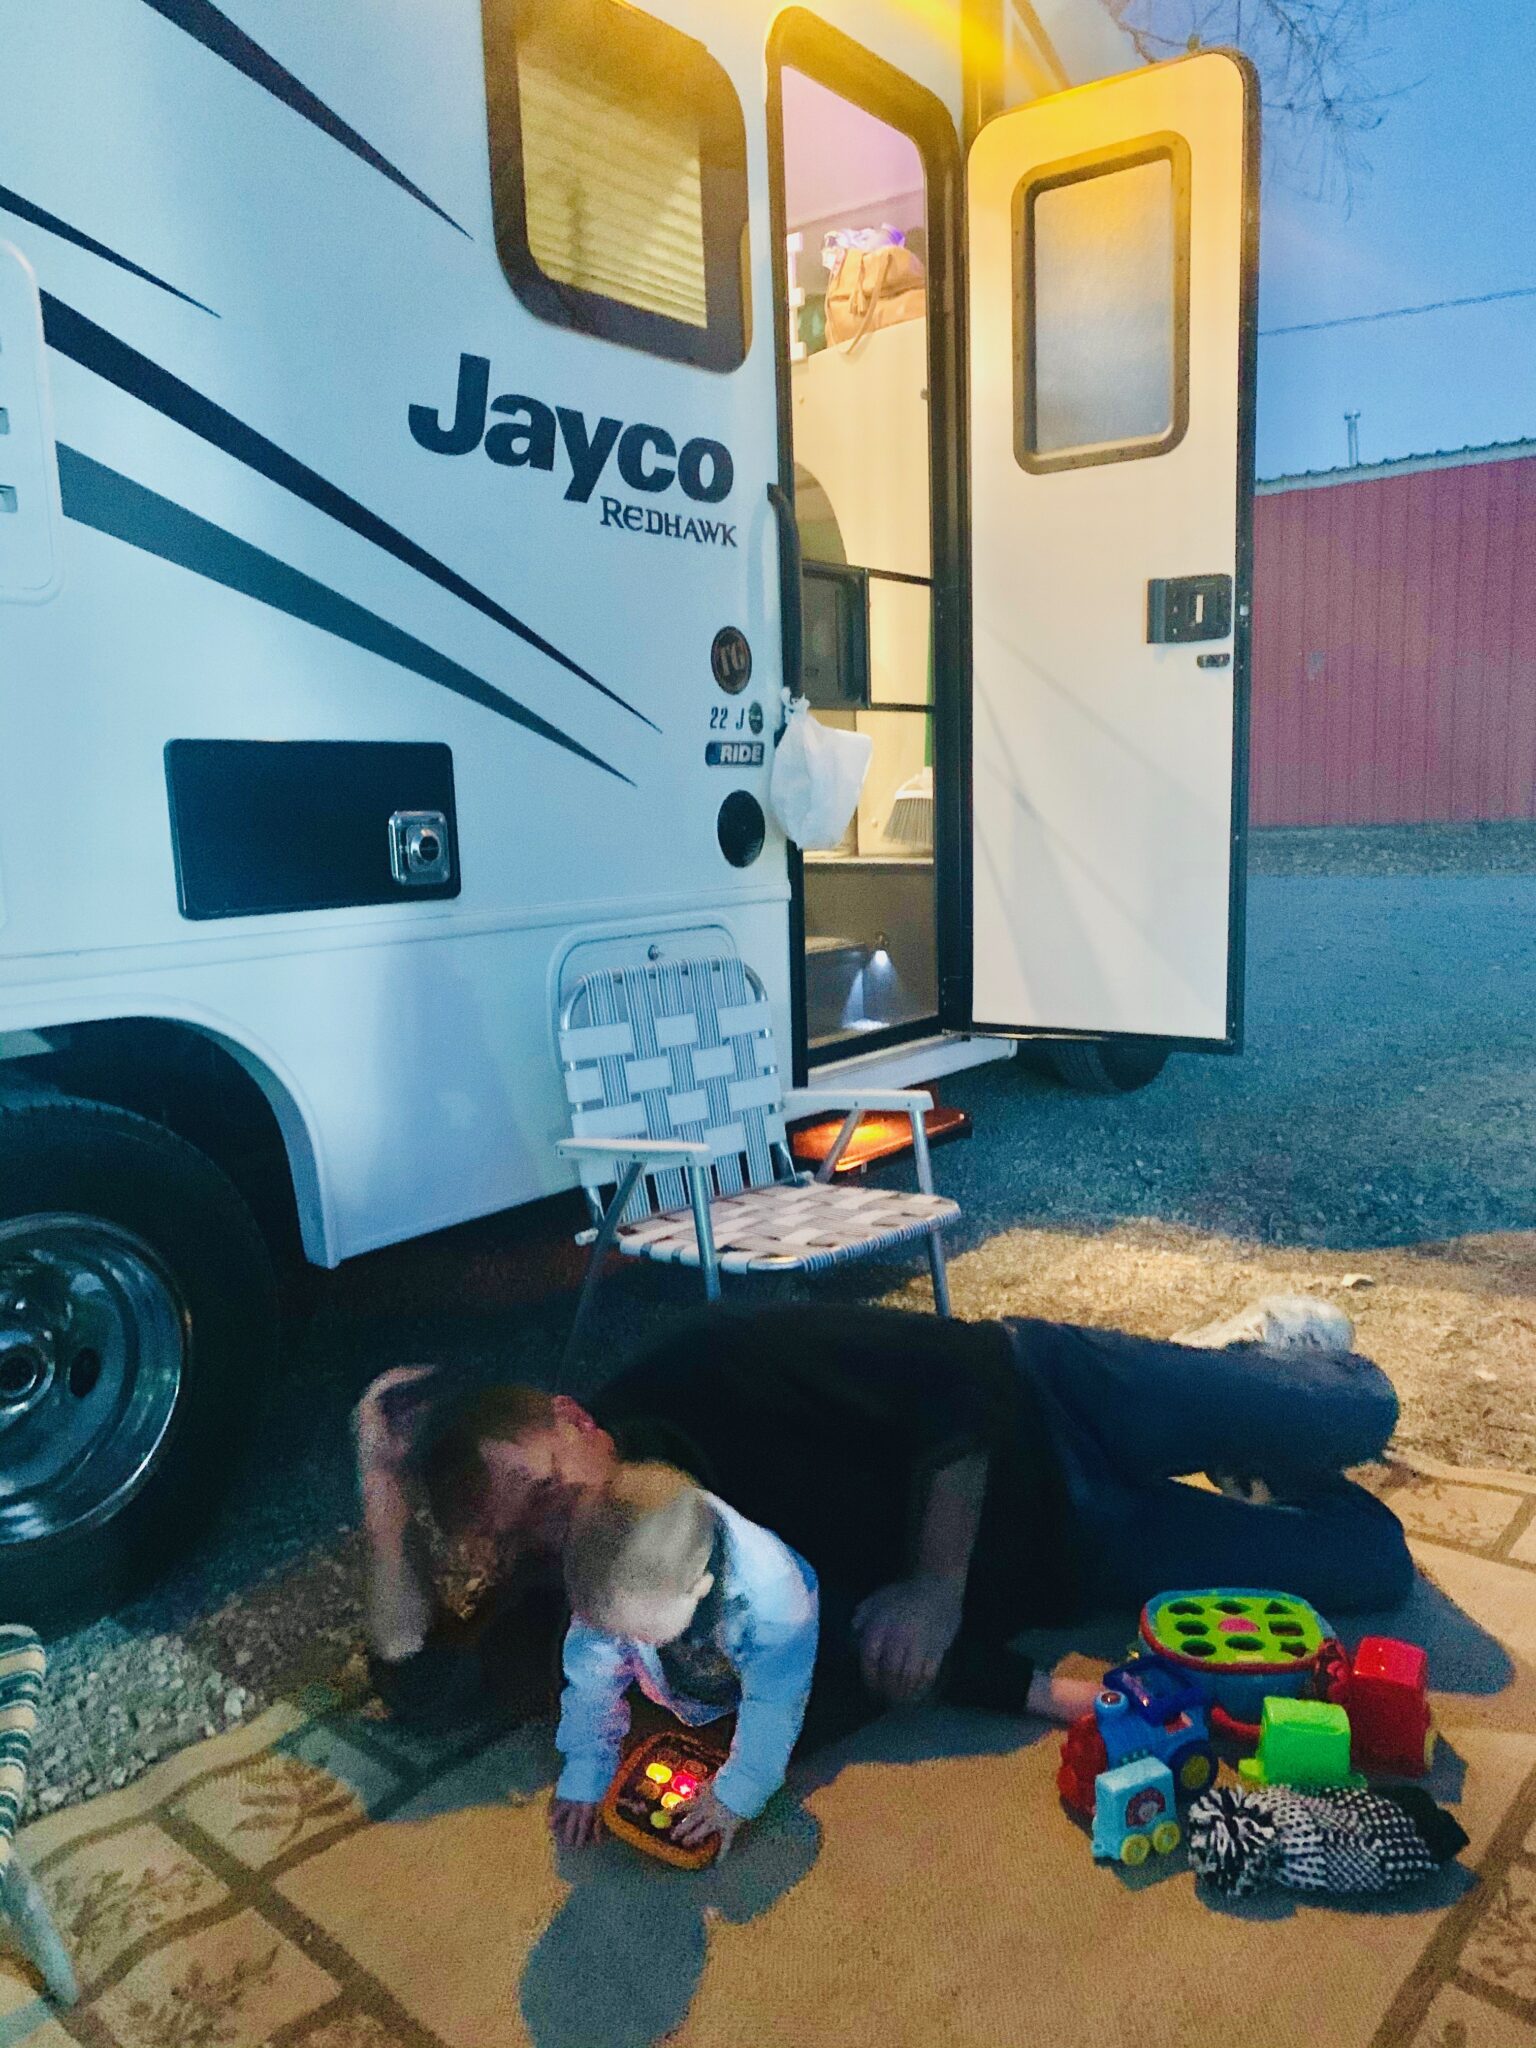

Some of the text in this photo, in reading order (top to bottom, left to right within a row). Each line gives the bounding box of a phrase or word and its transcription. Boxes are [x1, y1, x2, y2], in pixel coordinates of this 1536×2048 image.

[408, 352, 734, 503] Jayco
[710, 706, 728, 729] 22
[735, 707, 744, 730] J
